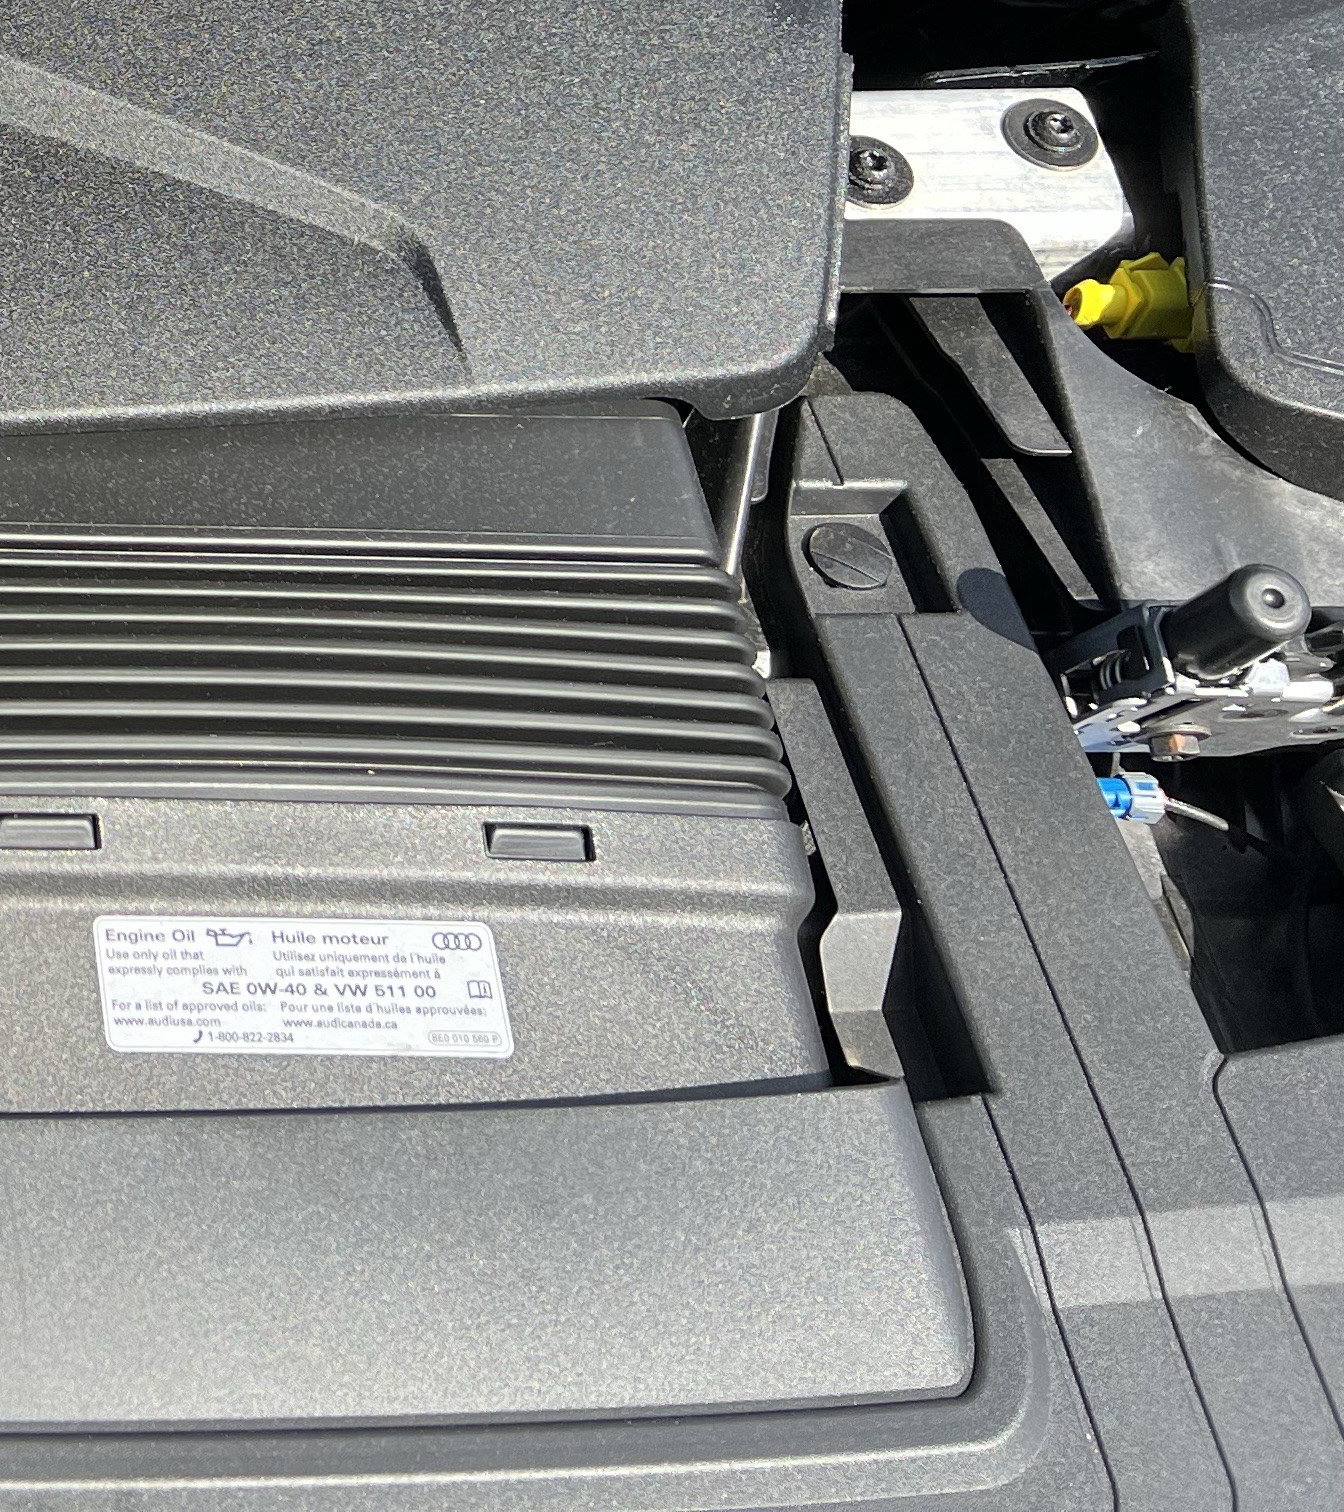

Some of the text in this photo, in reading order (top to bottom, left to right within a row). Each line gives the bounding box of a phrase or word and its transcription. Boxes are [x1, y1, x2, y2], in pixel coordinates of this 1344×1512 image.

[105, 928, 194, 945] Engine Oil
[271, 930, 389, 945] Huile moteur
[106, 949, 203, 961] Use only oil that
[273, 951, 445, 964] Utilisez uniquement de l'huile
[107, 963, 247, 977] expressly complies with
[275, 966, 294, 977] qui
[298, 966, 344, 977] satisfait
[202, 981, 436, 997] SAE 0W-40 & VW 511 00
[111, 998, 266, 1014] For a list of approved oils:
[280, 1001, 309, 1012] Pour
[311, 1004, 333, 1012] une
[337, 1002, 361, 1013] liste
[365, 1003, 411, 1014] d'huiles
[113, 1015, 220, 1026] www.audiusa.com
[282, 1018, 397, 1028] www.audicanada.ca
[208, 1031, 294, 1042] 1-800-822-2834
